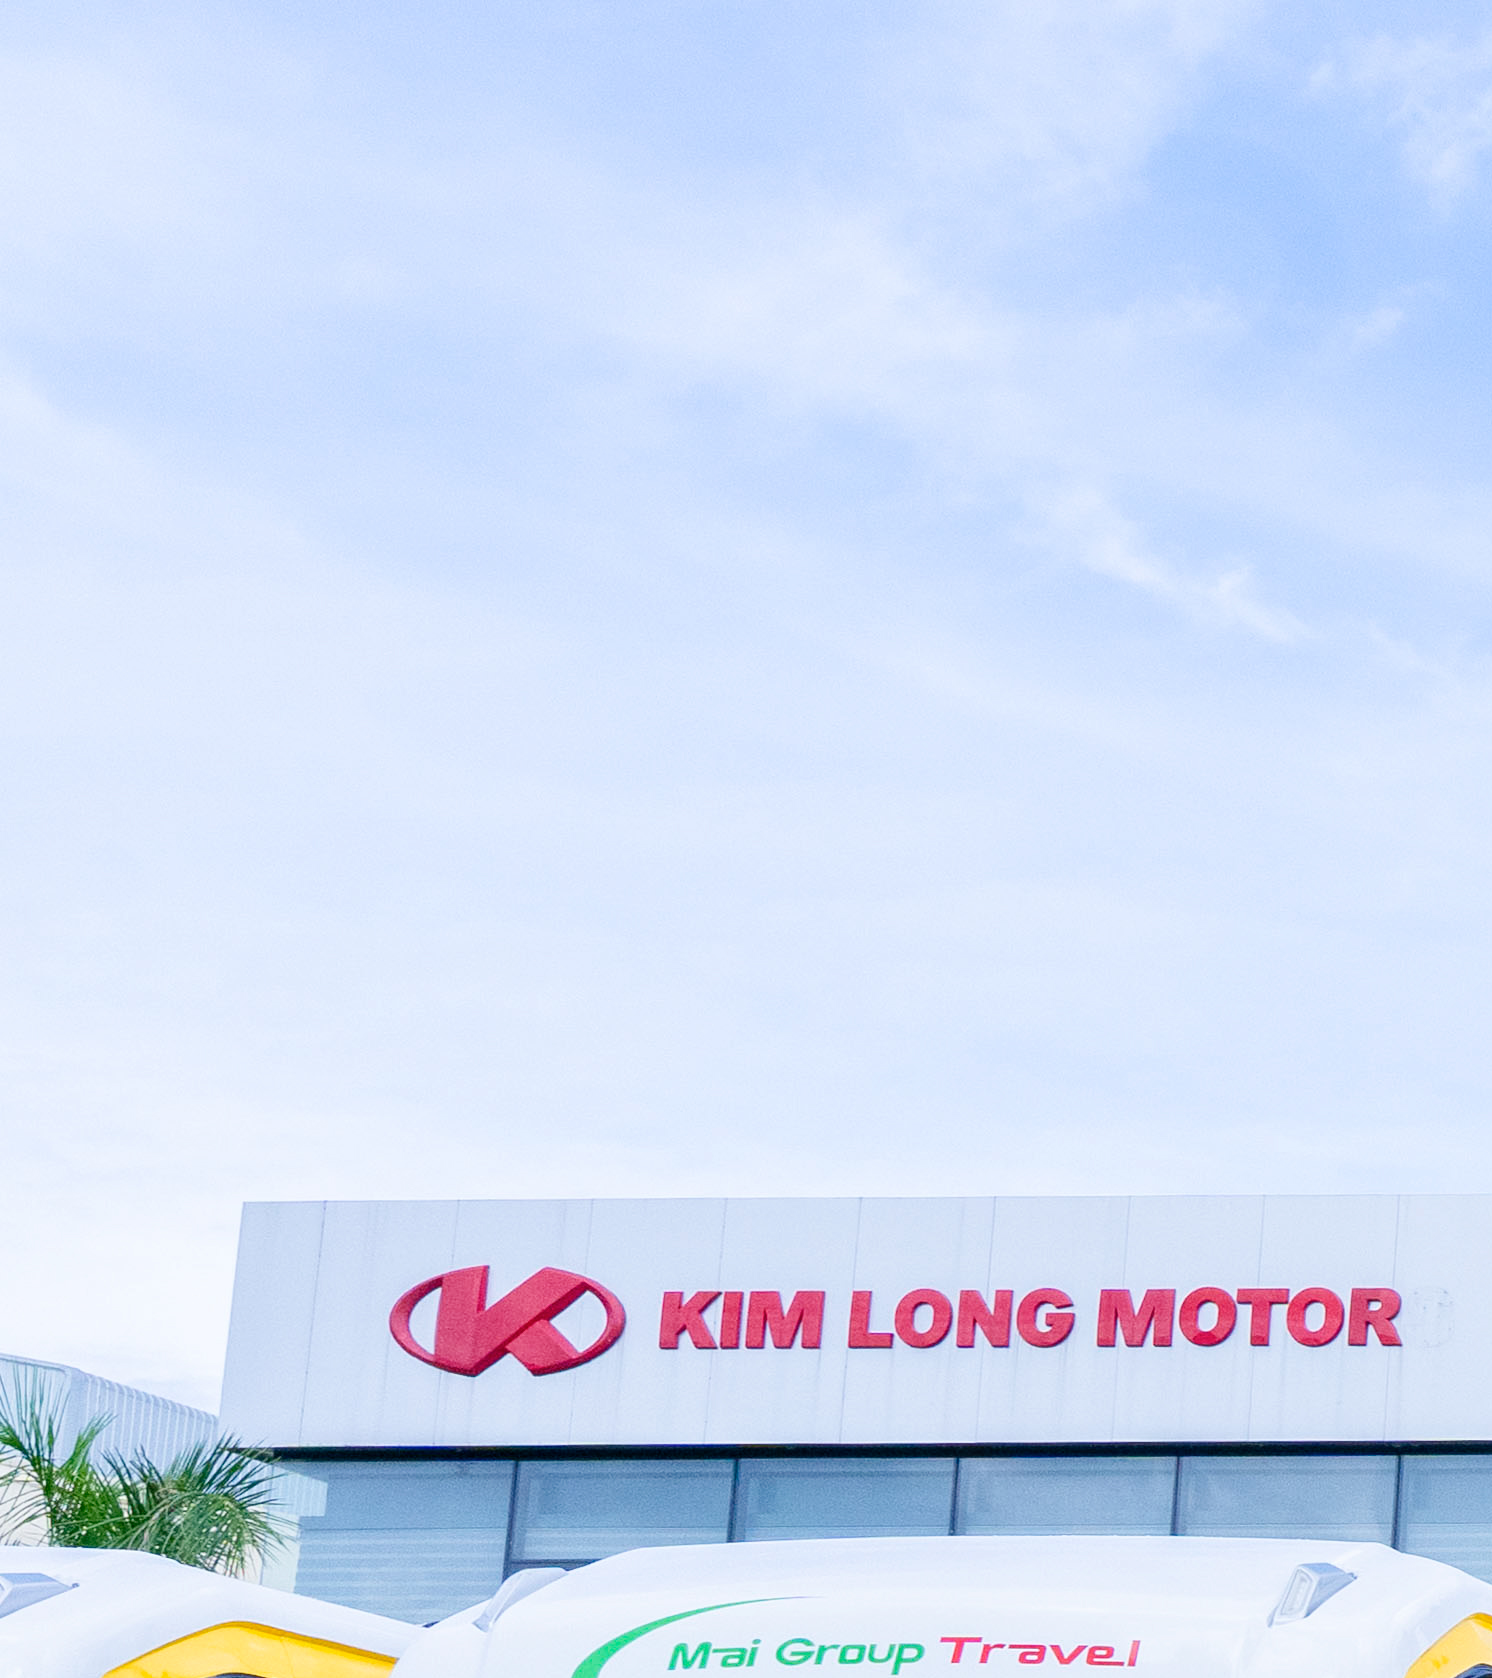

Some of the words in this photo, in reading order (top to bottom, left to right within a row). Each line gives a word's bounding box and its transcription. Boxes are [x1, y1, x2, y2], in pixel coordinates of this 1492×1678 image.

[659, 1291, 825, 1350] KIM
[848, 1288, 1075, 1349] LONG
[1097, 1287, 1403, 1348] MOTOR
[776, 1638, 924, 1675] Group
[940, 1637, 1140, 1667] Travel
